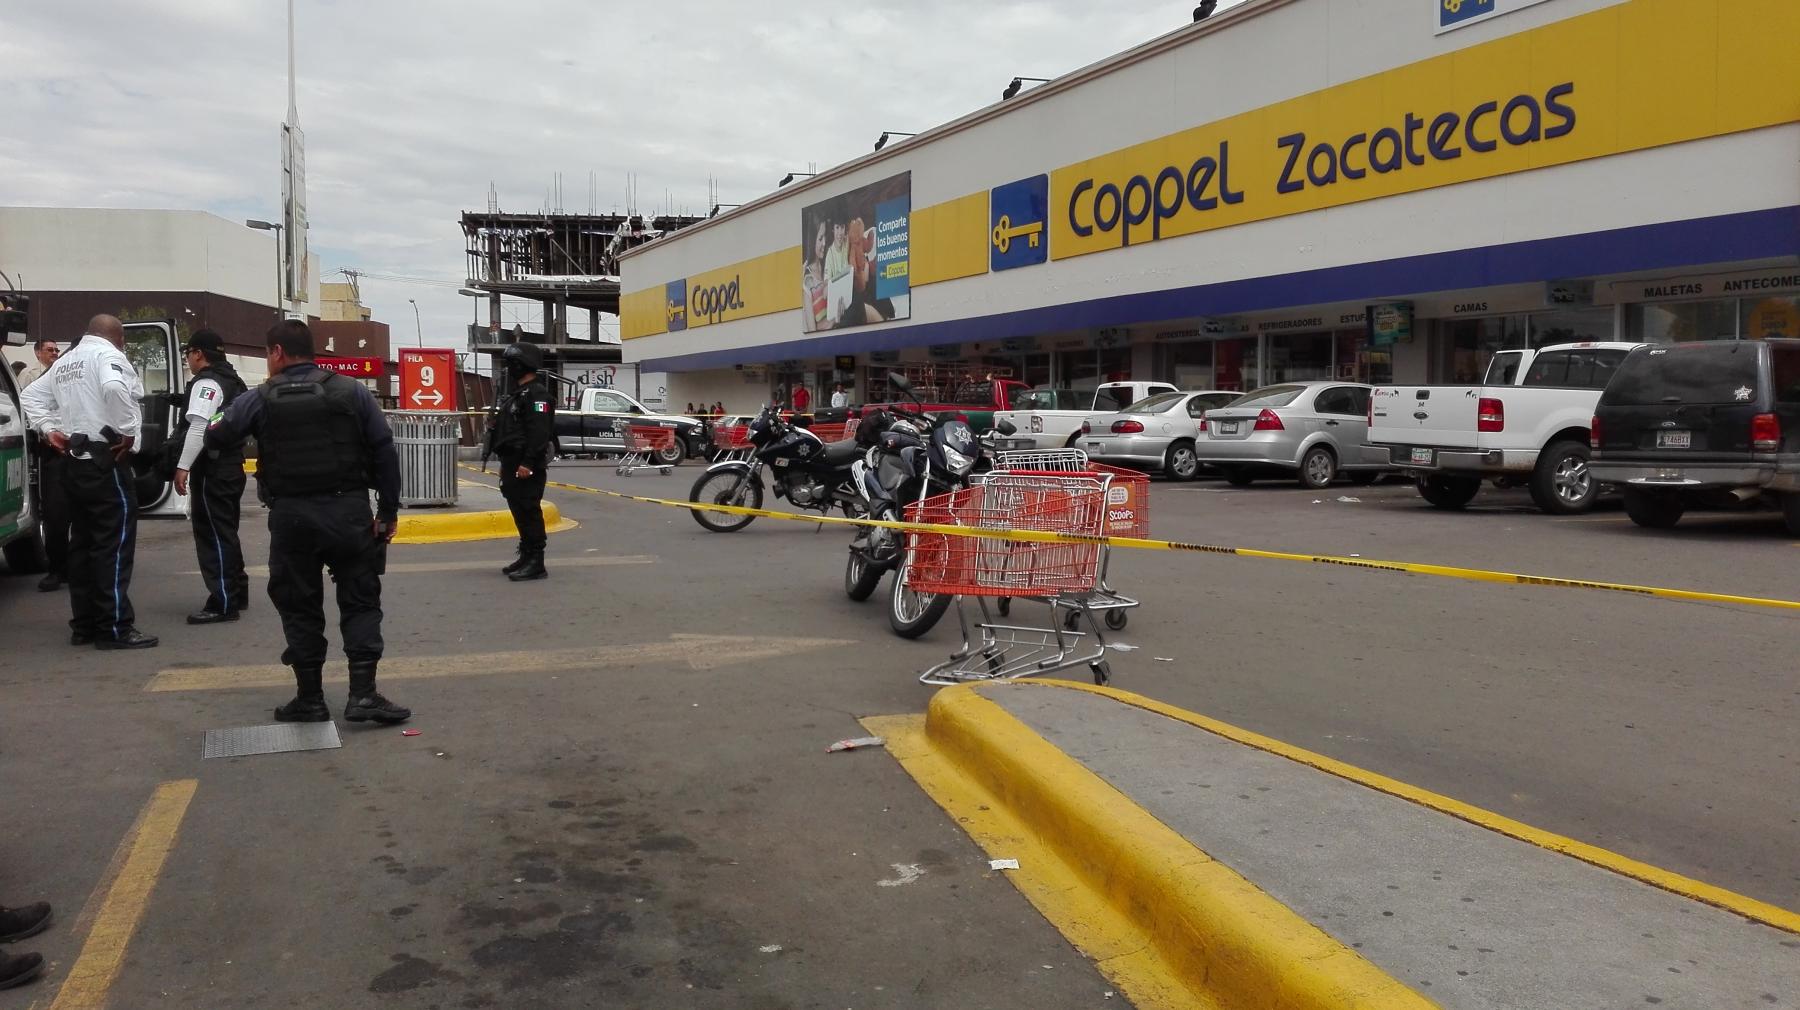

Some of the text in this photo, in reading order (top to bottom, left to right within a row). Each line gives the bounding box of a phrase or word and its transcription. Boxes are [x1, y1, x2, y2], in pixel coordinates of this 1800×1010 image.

[1069, 82, 1576, 247] Coppel Zacatecas
[878, 216, 907, 233] Comparte
[877, 232, 908, 248] los buenos
[877, 246, 908, 262] momentos
[1644, 283, 1703, 298] MALETAS
[692, 274, 744, 324] Coppel
[1454, 302, 1488, 313] CAMAS
[1258, 318, 1322, 331] REFRIGERADORES
[407, 355, 424, 363] FILA
[56, 361, 84, 375] POLICIA
[420, 366, 434, 387] 9
[579, 369, 614, 386] dish
